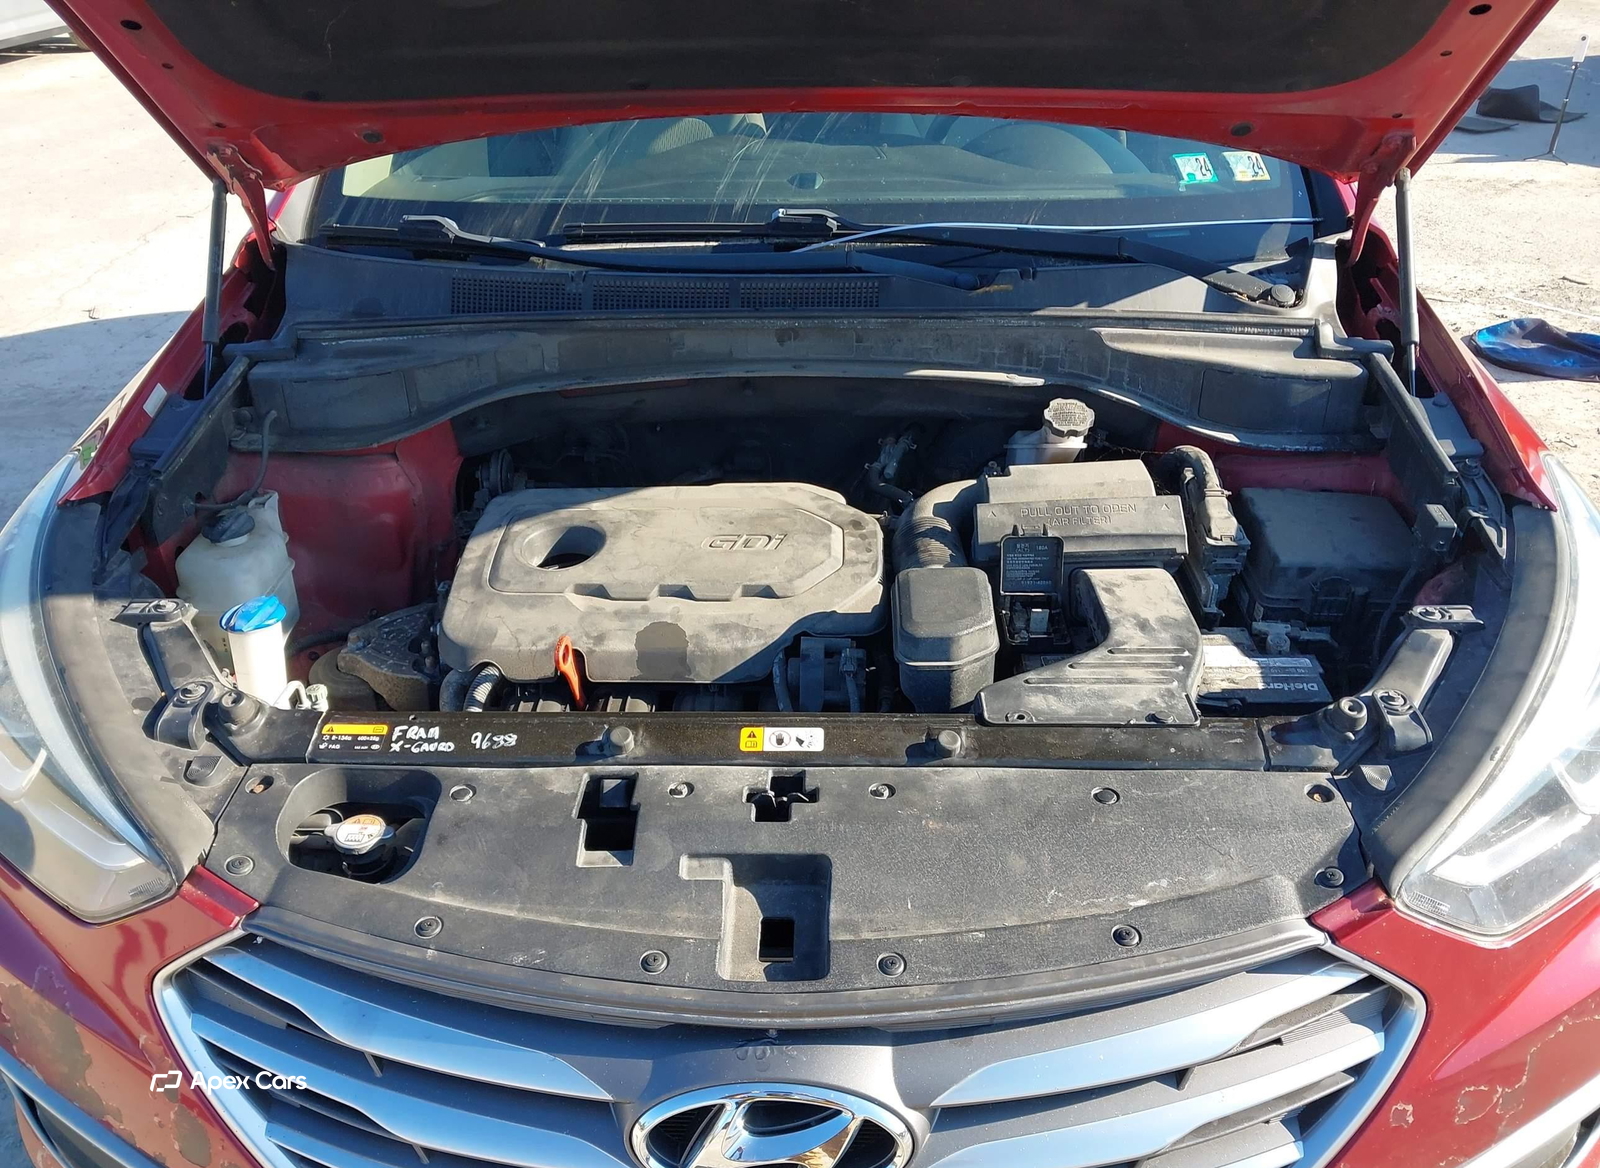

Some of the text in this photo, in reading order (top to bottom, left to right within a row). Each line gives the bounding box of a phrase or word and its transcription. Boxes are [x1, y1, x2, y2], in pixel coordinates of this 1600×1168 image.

[1195, 157, 1213, 177] 24
[1247, 155, 1266, 178] 24
[1020, 503, 1137, 518] PULL OUT TO OPEN
[1047, 515, 1113, 528] (AIR FILTER)
[700, 533, 788, 551] GDi
[1257, 682, 1319, 691] DieHard
[391, 725, 440, 741] FRAM
